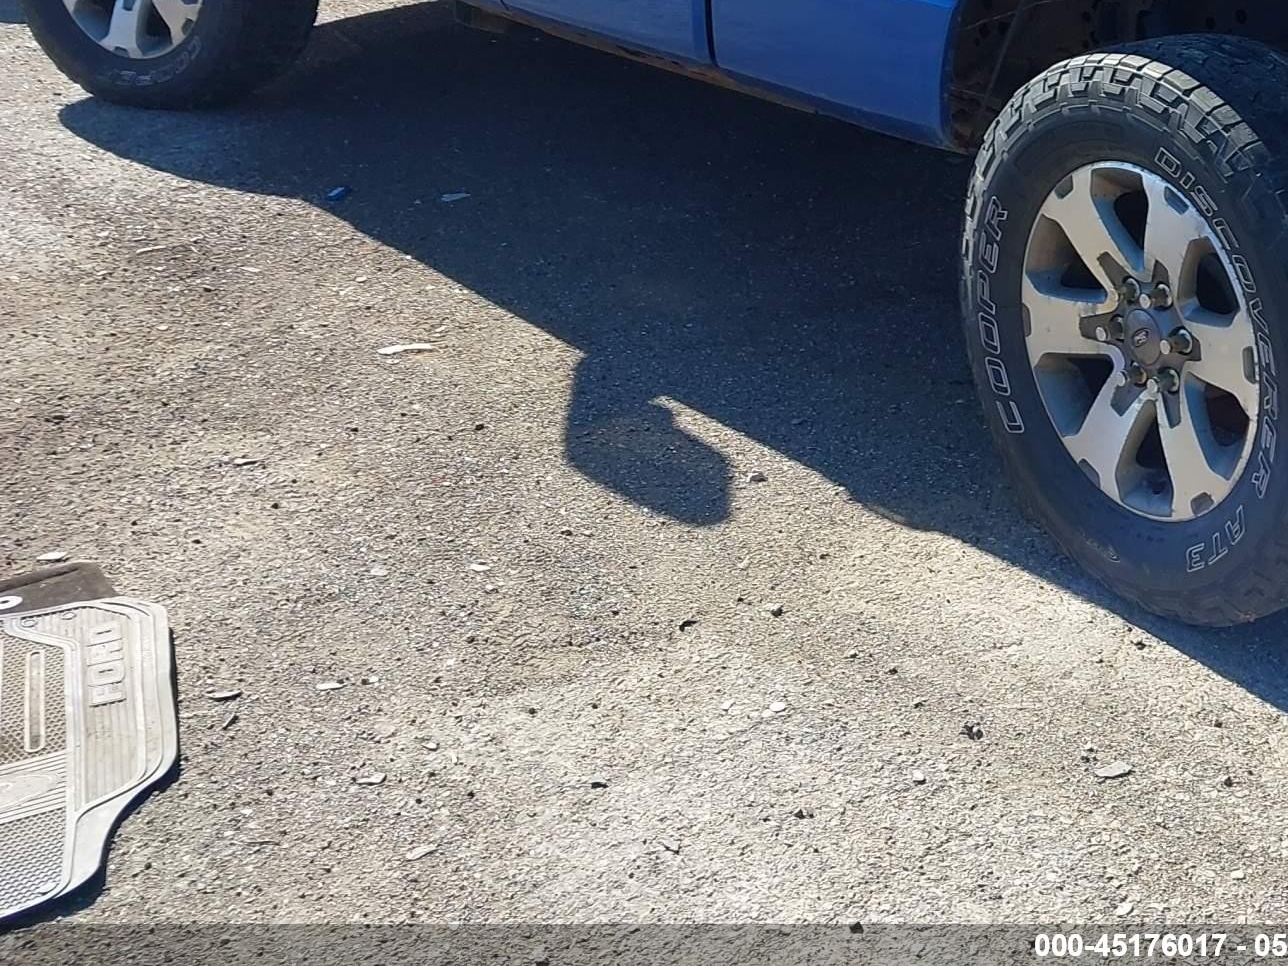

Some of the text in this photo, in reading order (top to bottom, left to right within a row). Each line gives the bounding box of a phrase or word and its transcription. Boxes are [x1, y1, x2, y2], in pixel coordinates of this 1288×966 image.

[972, 196, 1025, 434] COOPER
[1154, 146, 1280, 499] DISCOVERER
[1186, 504, 1247, 574] AT3
